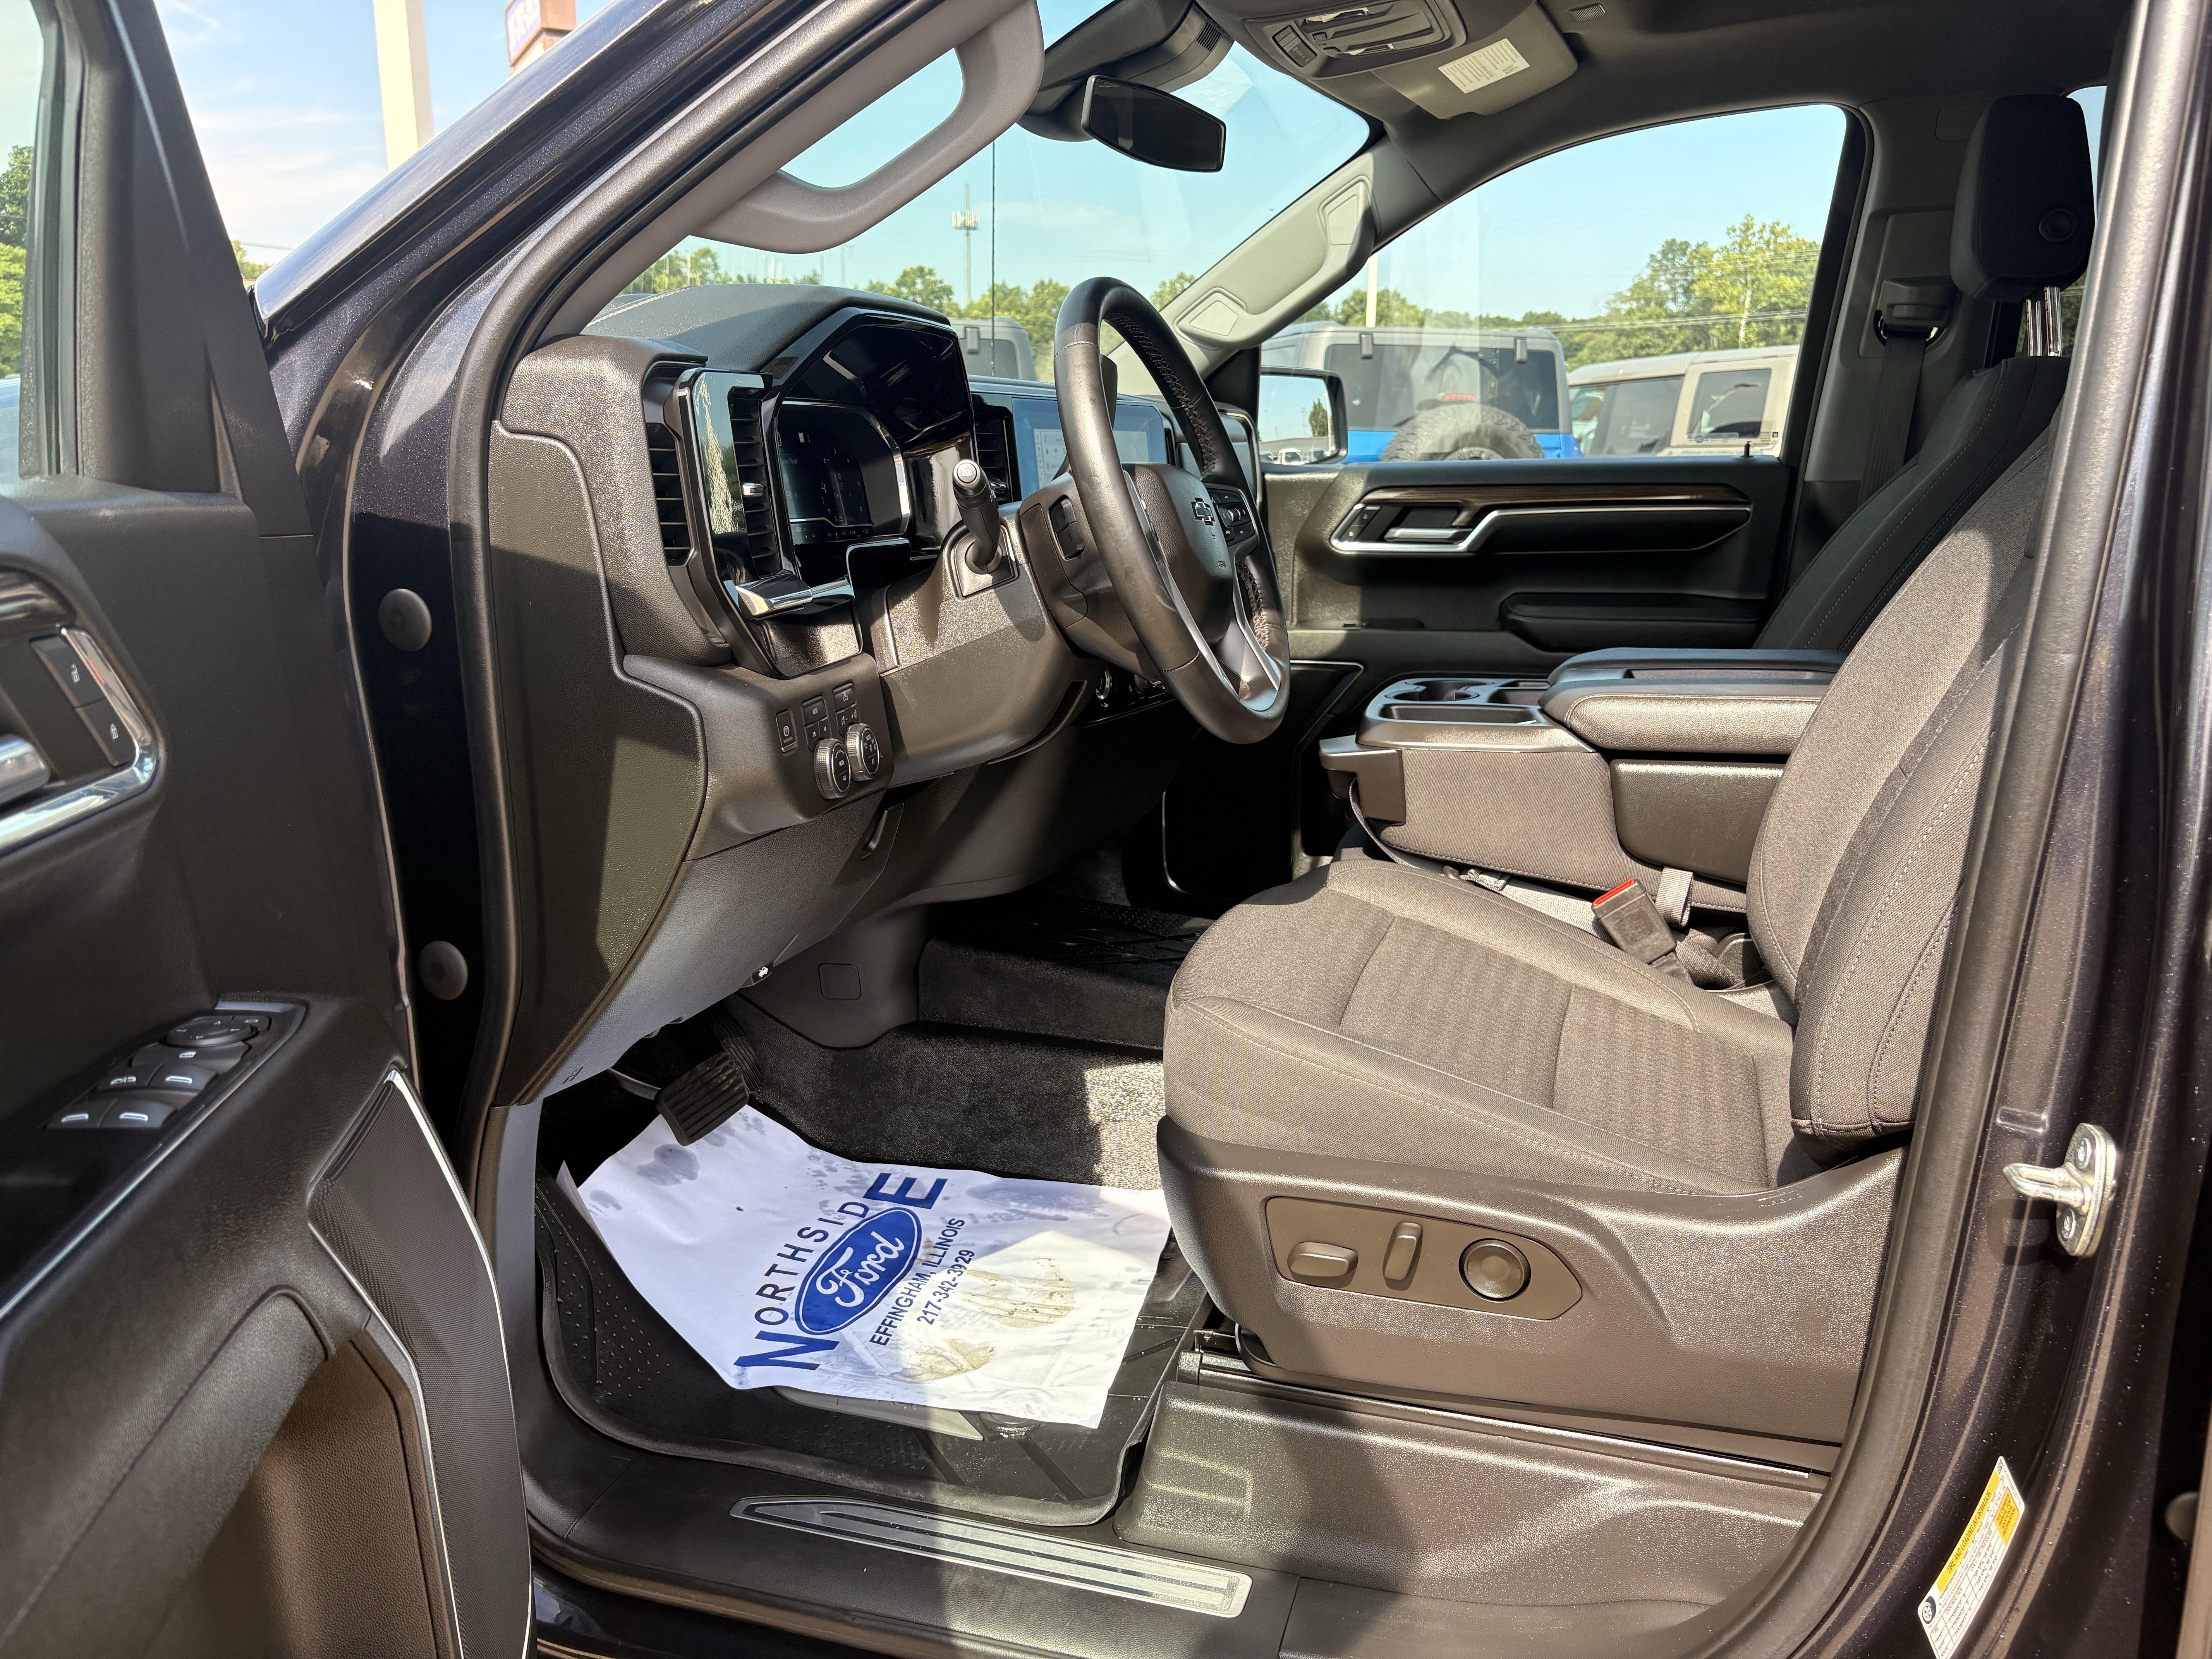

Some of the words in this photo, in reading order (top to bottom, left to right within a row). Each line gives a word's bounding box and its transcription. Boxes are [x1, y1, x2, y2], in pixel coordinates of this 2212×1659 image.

[733, 1172, 948, 1370] NORTHSIDE
[816, 1231, 905, 1307] Ford
[869, 1271, 937, 1346] EFFINGHAM,
[922, 1218, 965, 1267] ILLINOIS
[917, 1250, 975, 1325] 217-342-3929
[1947, 1558, 1956, 1573] TIRE
[1960, 1525, 1974, 1549] LOADING
[1972, 1489, 1991, 1528] INFORMATION
